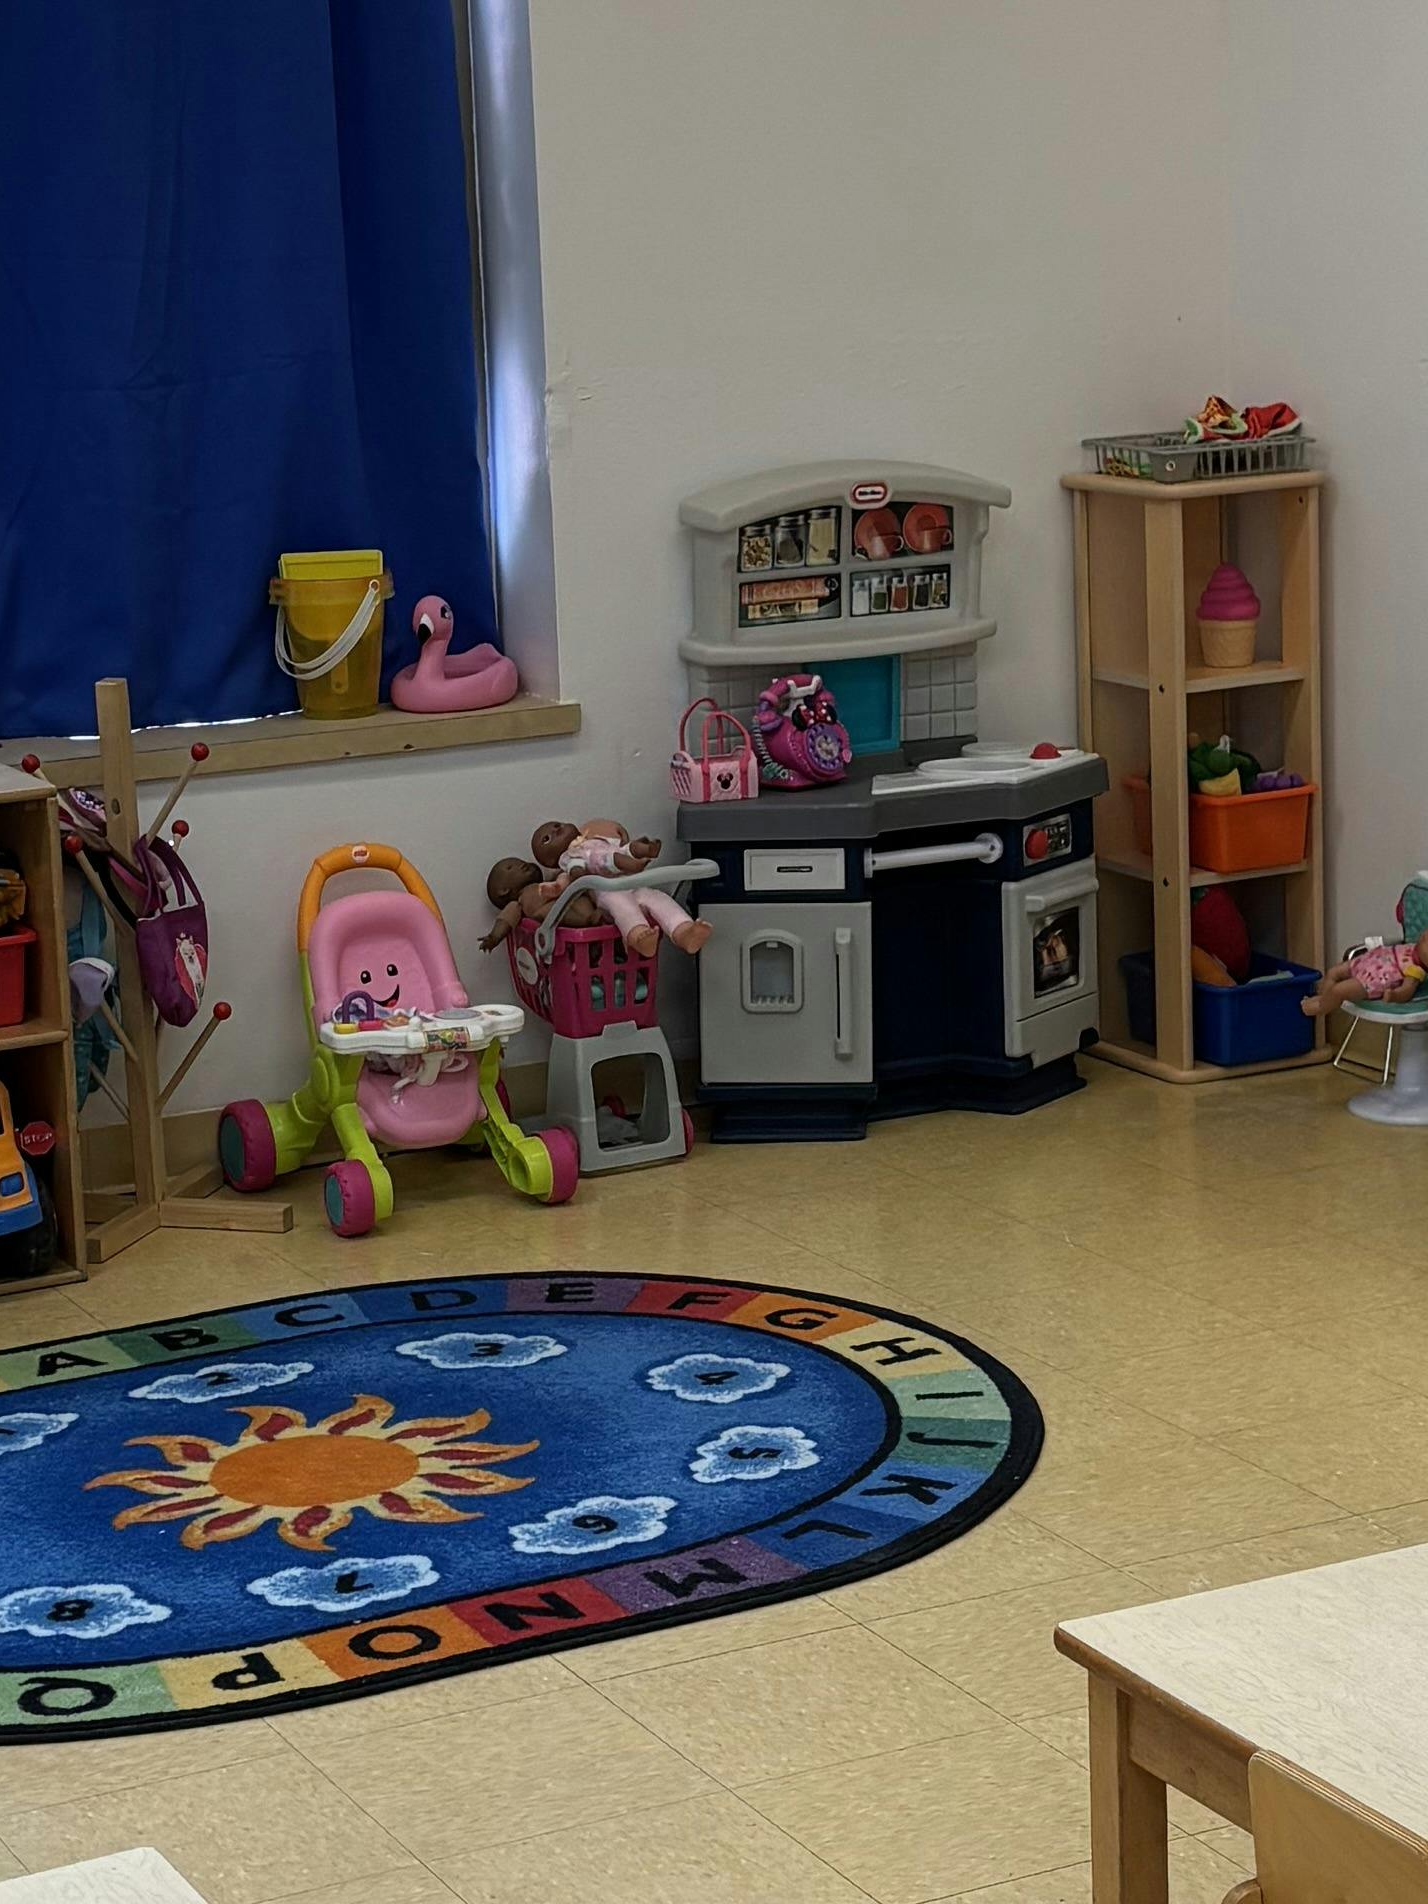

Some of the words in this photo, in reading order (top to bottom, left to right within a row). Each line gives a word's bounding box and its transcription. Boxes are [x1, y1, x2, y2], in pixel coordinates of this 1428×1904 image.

[409, 1289, 478, 1311] D
[544, 1282, 595, 1304] E
[667, 1291, 731, 1310] F
[274, 1303, 346, 1328] C
[765, 1307, 840, 1331] G
[150, 1326, 219, 1351] B
[468, 1342, 506, 1357] 3
[849, 1337, 942, 1366] H
[36, 1351, 108, 1376] A
[204, 1371, 240, 1386] 2
[693, 1370, 739, 1386] 4
[915, 1391, 984, 1400] I
[907, 1431, 997, 1448] J
[727, 1445, 783, 1460] 5
[860, 1473, 958, 1506] K
[572, 1515, 620, 1534] 6
[782, 1520, 871, 1541] L
[334, 1570, 374, 1594] 7
[643, 1559, 747, 1599] M
[47, 1599, 93, 1622] 8
[484, 1592, 586, 1632] N
[349, 1625, 441, 1660] O
[212, 1652, 284, 1690] P
[17, 1677, 115, 1716] Q
